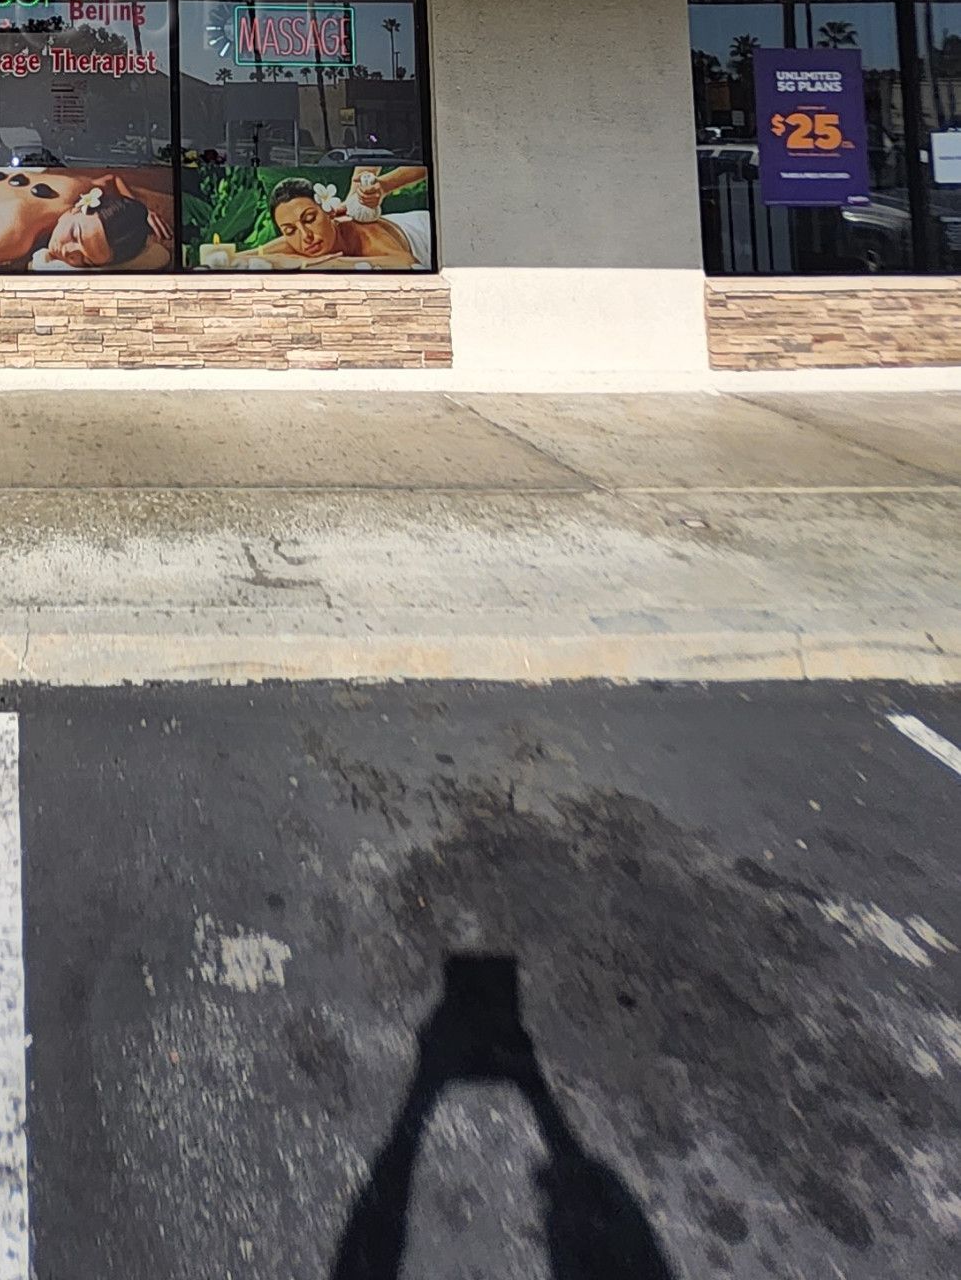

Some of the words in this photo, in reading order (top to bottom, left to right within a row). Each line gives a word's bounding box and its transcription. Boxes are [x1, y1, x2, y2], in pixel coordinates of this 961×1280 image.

[239, 16, 351, 56] MASSAGE
[49, 47, 158, 78] Therapist
[776, 71, 842, 81] UNLIMITED
[777, 81, 796, 92] 5G
[798, 81, 843, 92] PLANS
[770, 113, 842, 150] $25
